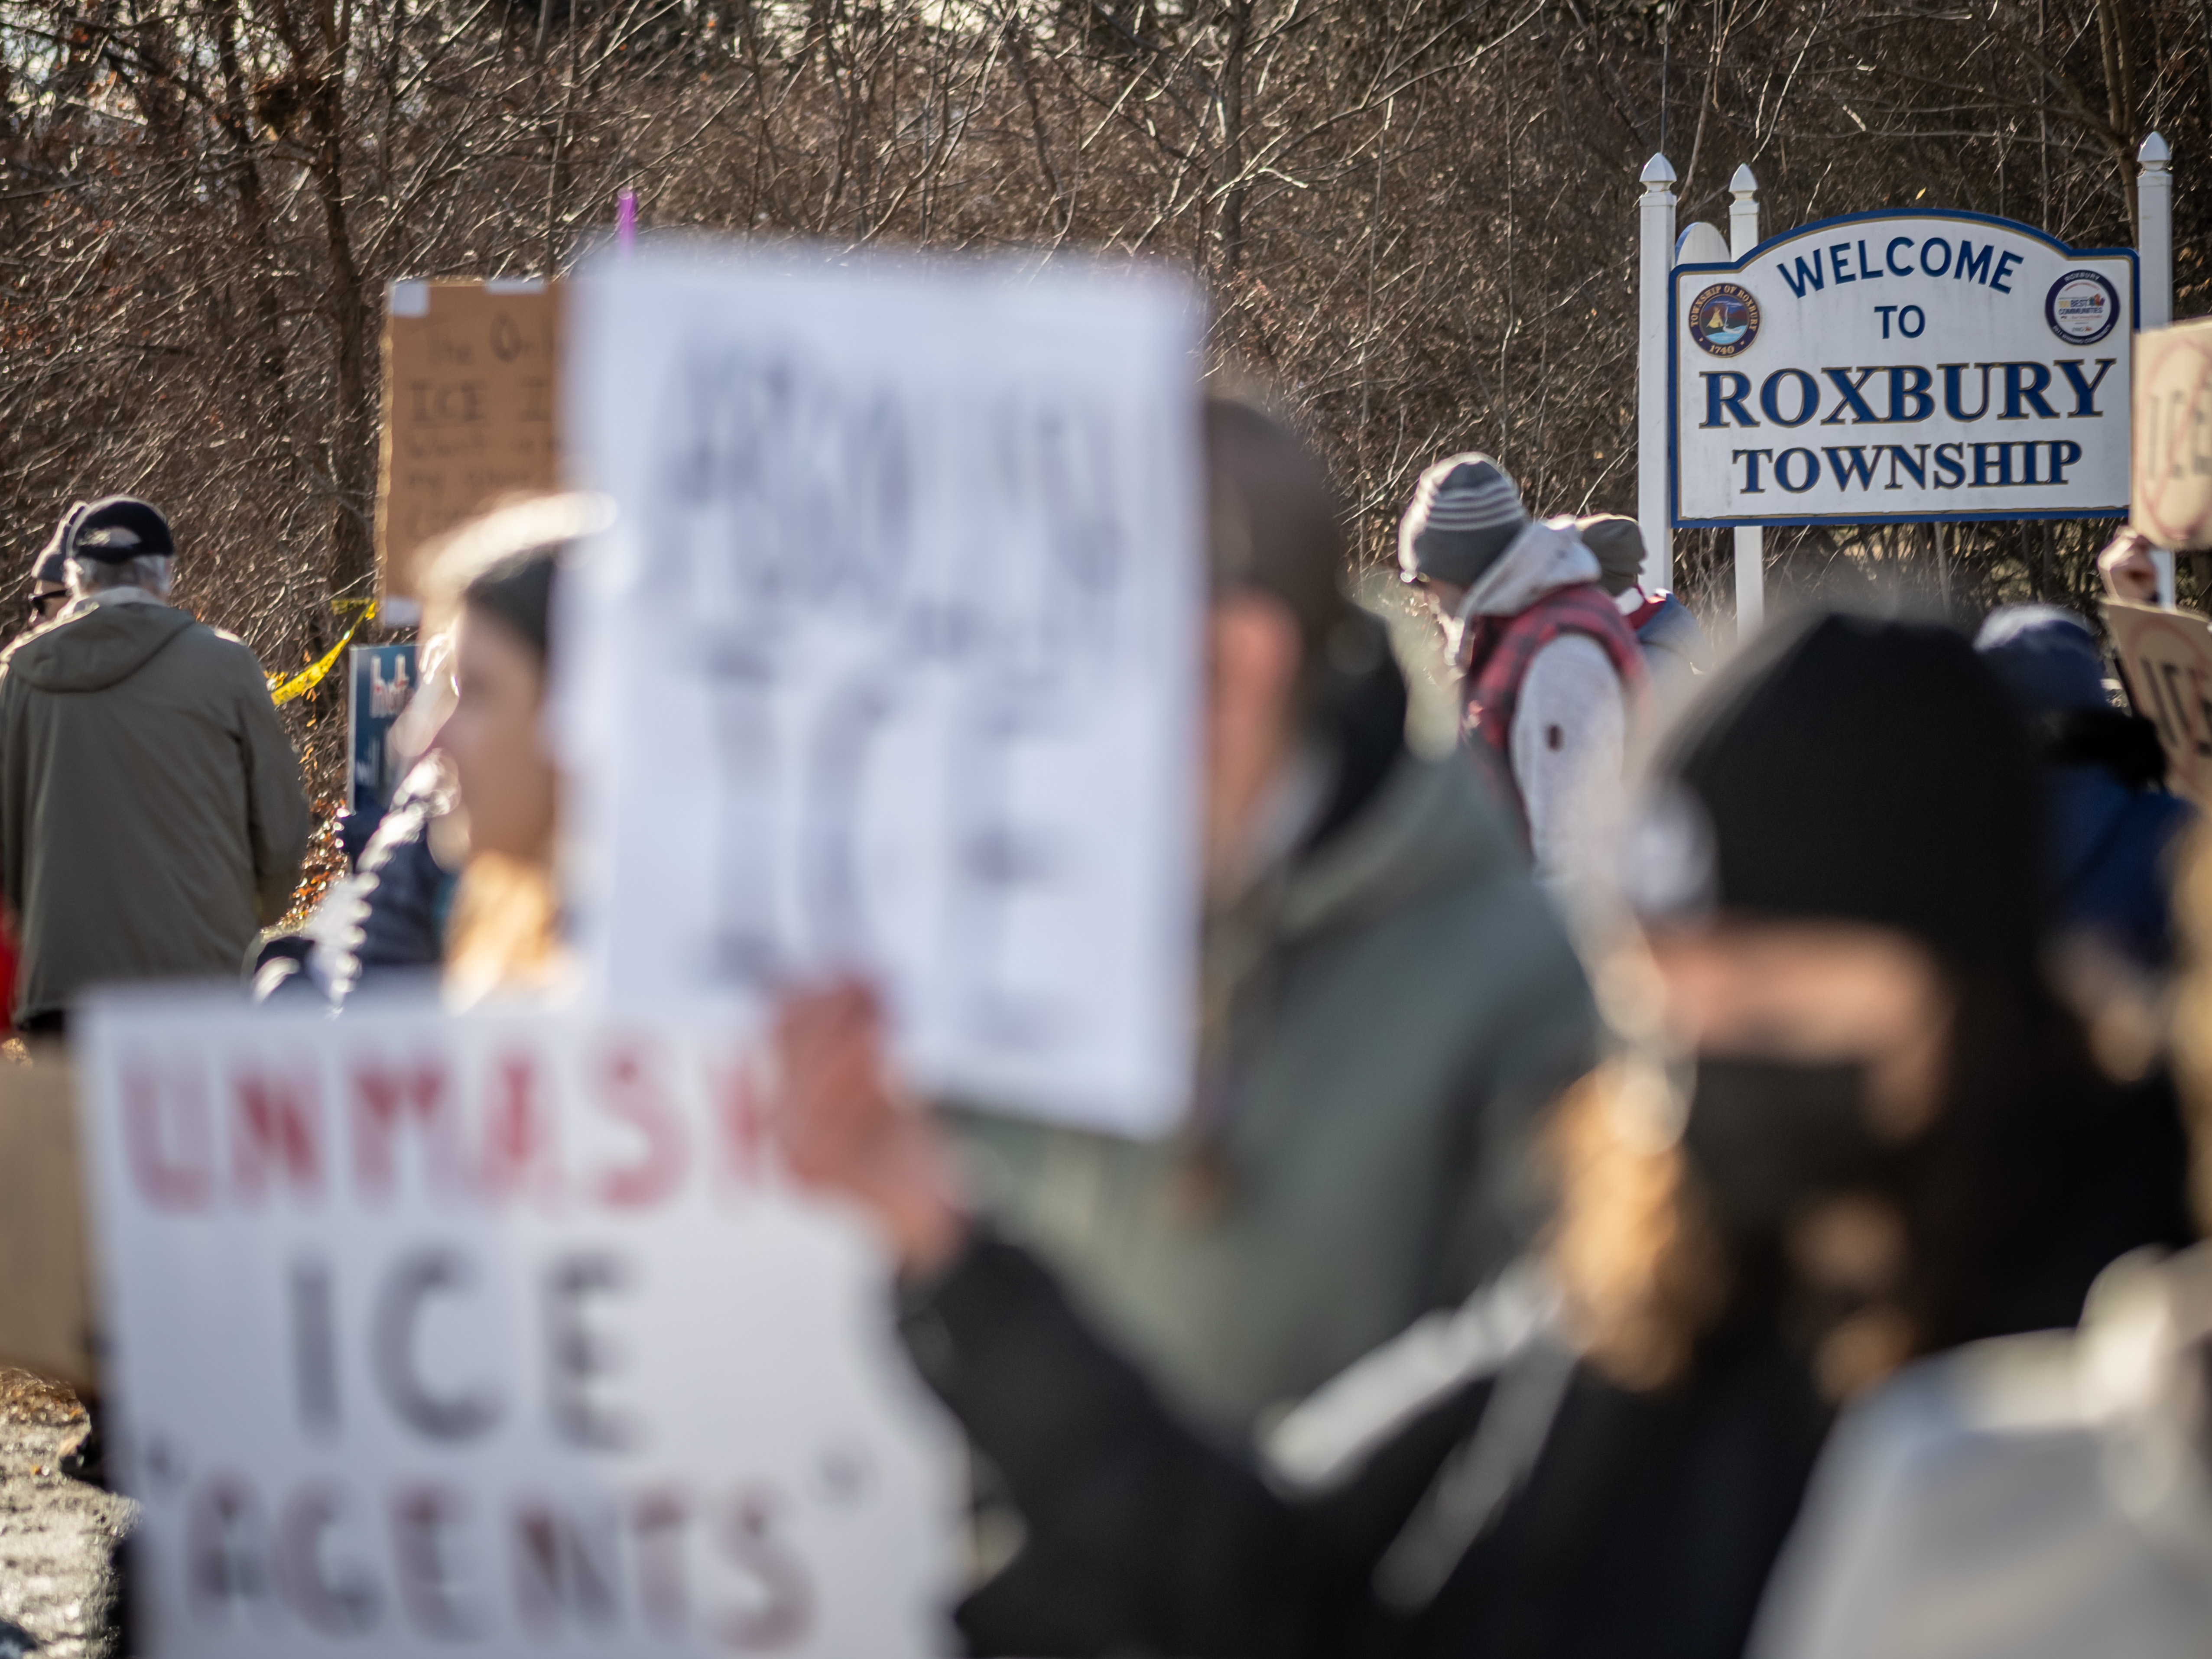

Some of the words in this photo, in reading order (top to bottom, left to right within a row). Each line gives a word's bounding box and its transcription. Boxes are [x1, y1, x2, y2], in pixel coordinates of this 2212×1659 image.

[1777, 237, 2022, 297] WELCOME
[2064, 272, 2100, 282] ROXBURY
[1691, 286, 1722, 327] TOWNSHIP
[1724, 285, 1737, 294] OF
[1737, 290, 1758, 331] ROXBURY
[1874, 304, 1925, 339] TO
[1709, 345, 1735, 354] 1740
[1699, 359, 2117, 429] ROXBURY
[1733, 440, 2082, 493] TOWNSHIP
[289, 1246, 650, 1455] ICE
